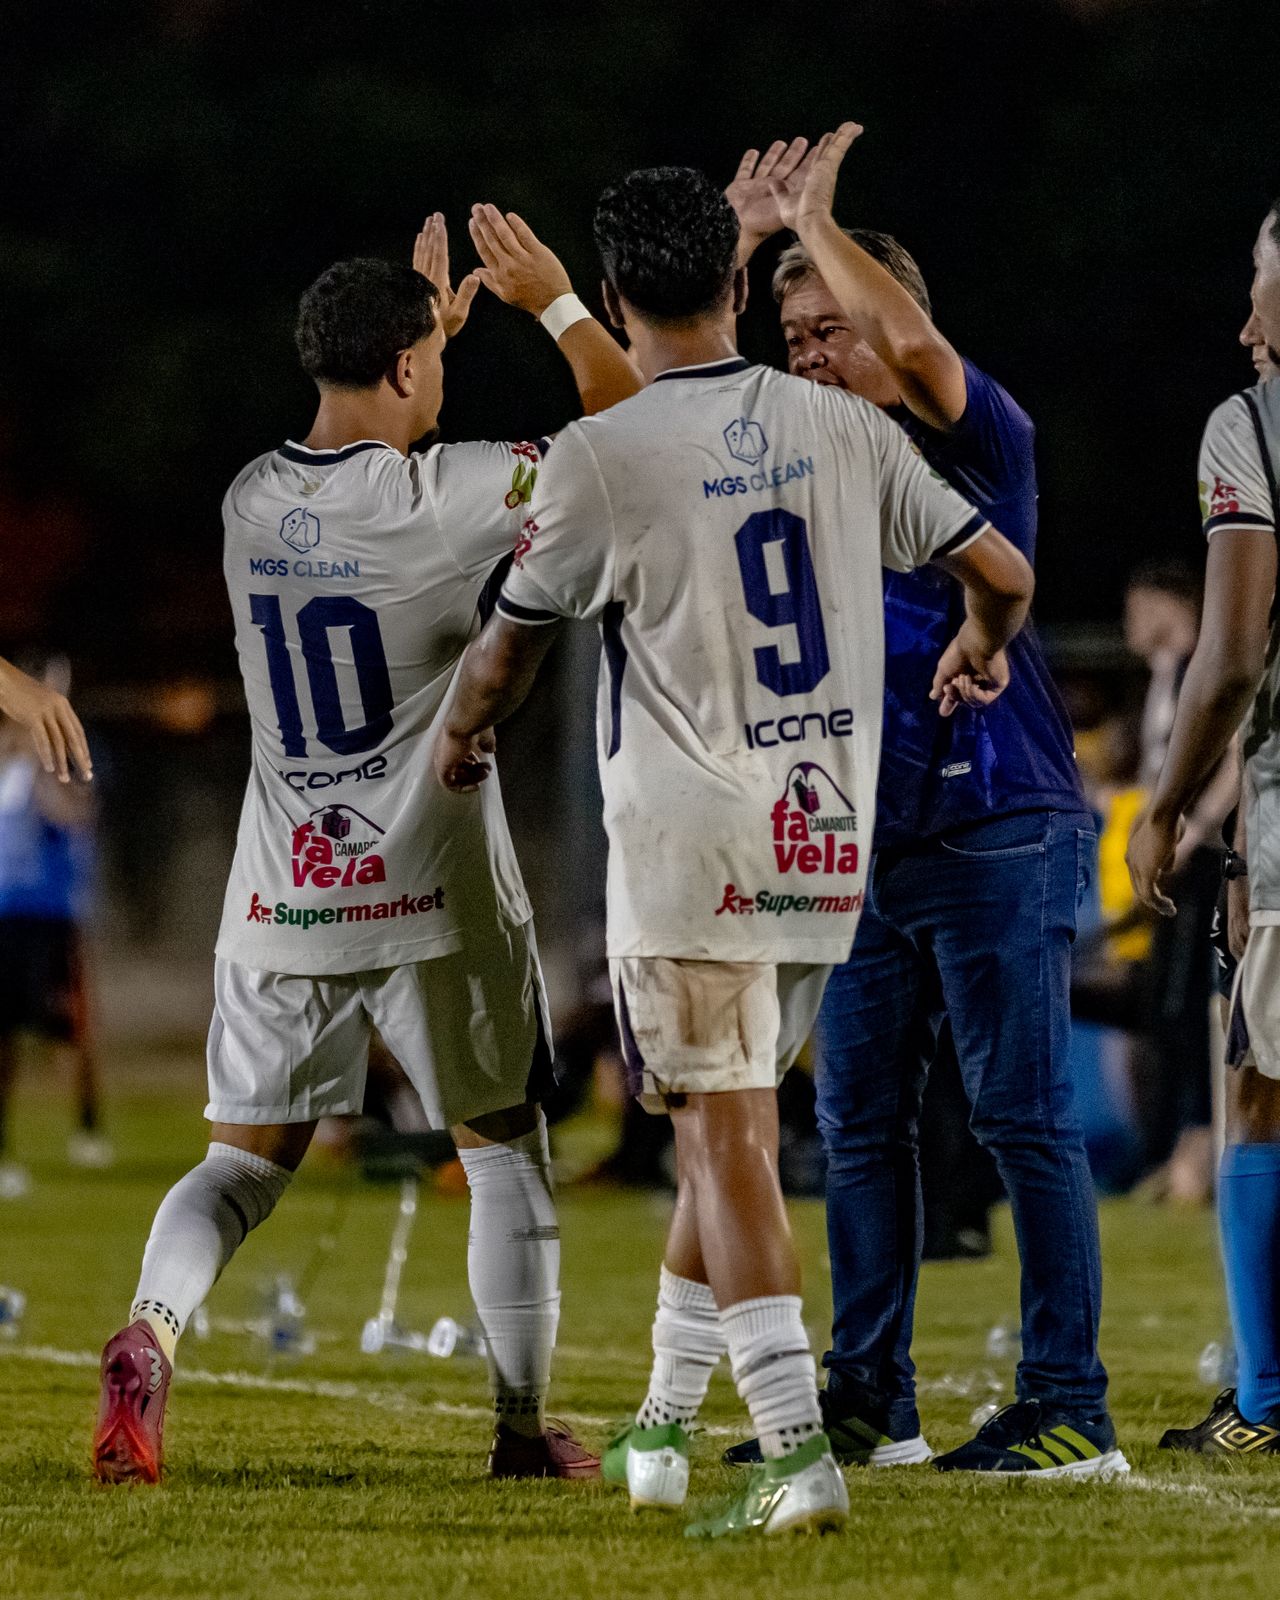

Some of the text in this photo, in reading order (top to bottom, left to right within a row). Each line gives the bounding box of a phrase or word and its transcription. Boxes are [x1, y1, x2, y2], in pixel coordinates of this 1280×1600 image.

[702, 456, 815, 499] MGS CLEAN
[249, 557, 361, 579] MGS CLEAN
[734, 507, 831, 698] 9
[248, 592, 395, 758] 10
[808, 815, 857, 833] CAMAROTE
[273, 886, 446, 930] Supermarket
